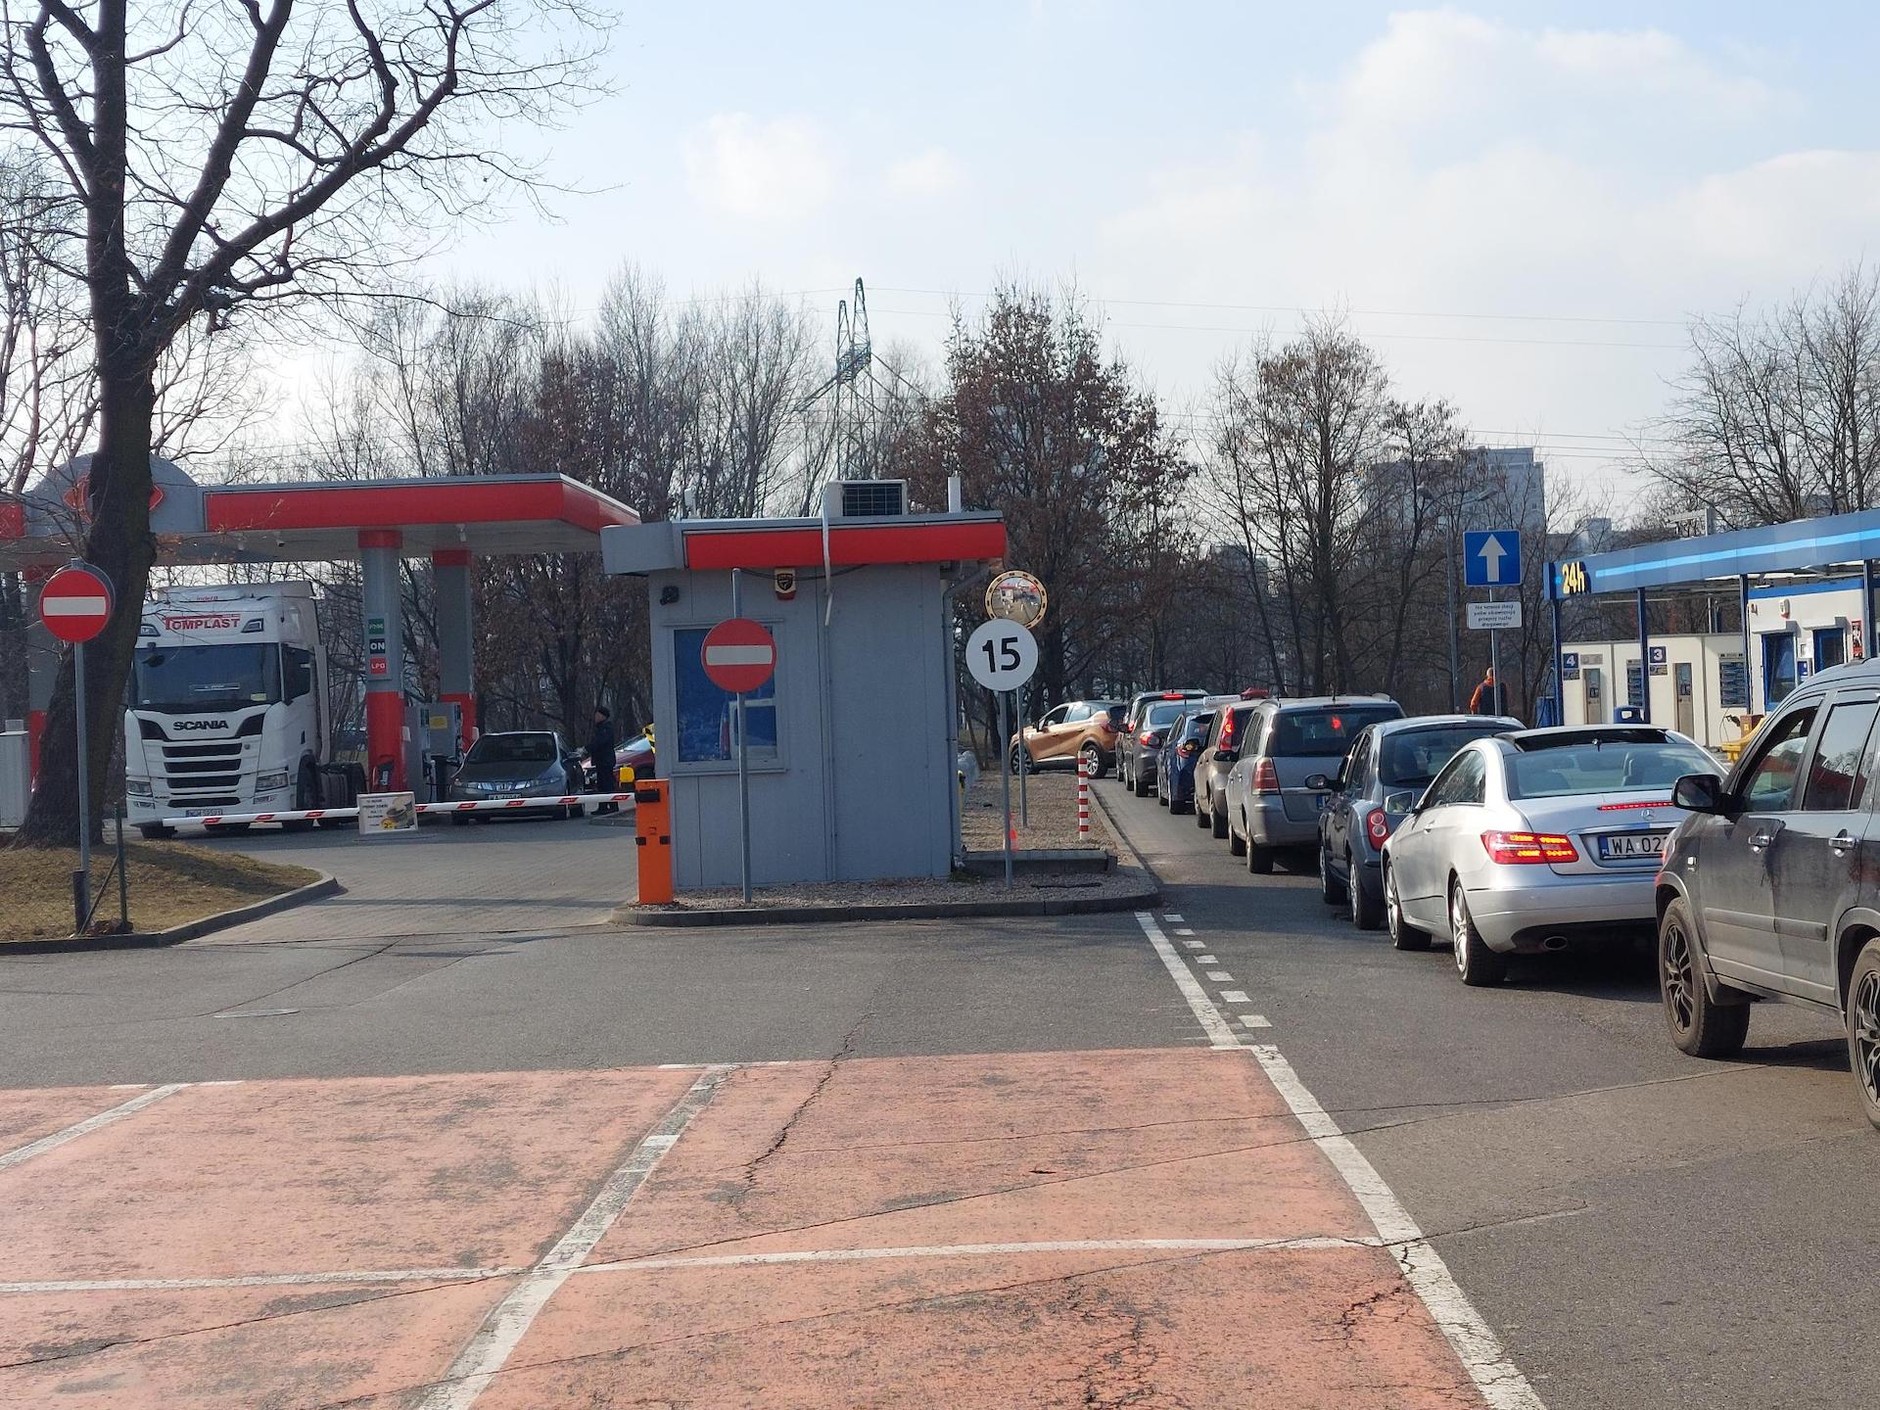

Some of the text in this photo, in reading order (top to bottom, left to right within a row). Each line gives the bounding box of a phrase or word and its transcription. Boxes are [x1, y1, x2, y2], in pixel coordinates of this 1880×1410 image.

[1562, 561, 1585, 594] 24h
[163, 613, 241, 631] TOMPLAST
[370, 642, 385, 650] ON
[982, 636, 1021, 673] 15
[1566, 655, 1576, 667] 4
[1653, 648, 1663, 661] 3
[173, 720, 229, 731] SCANIA
[1612, 836, 1668, 854] WA 02
